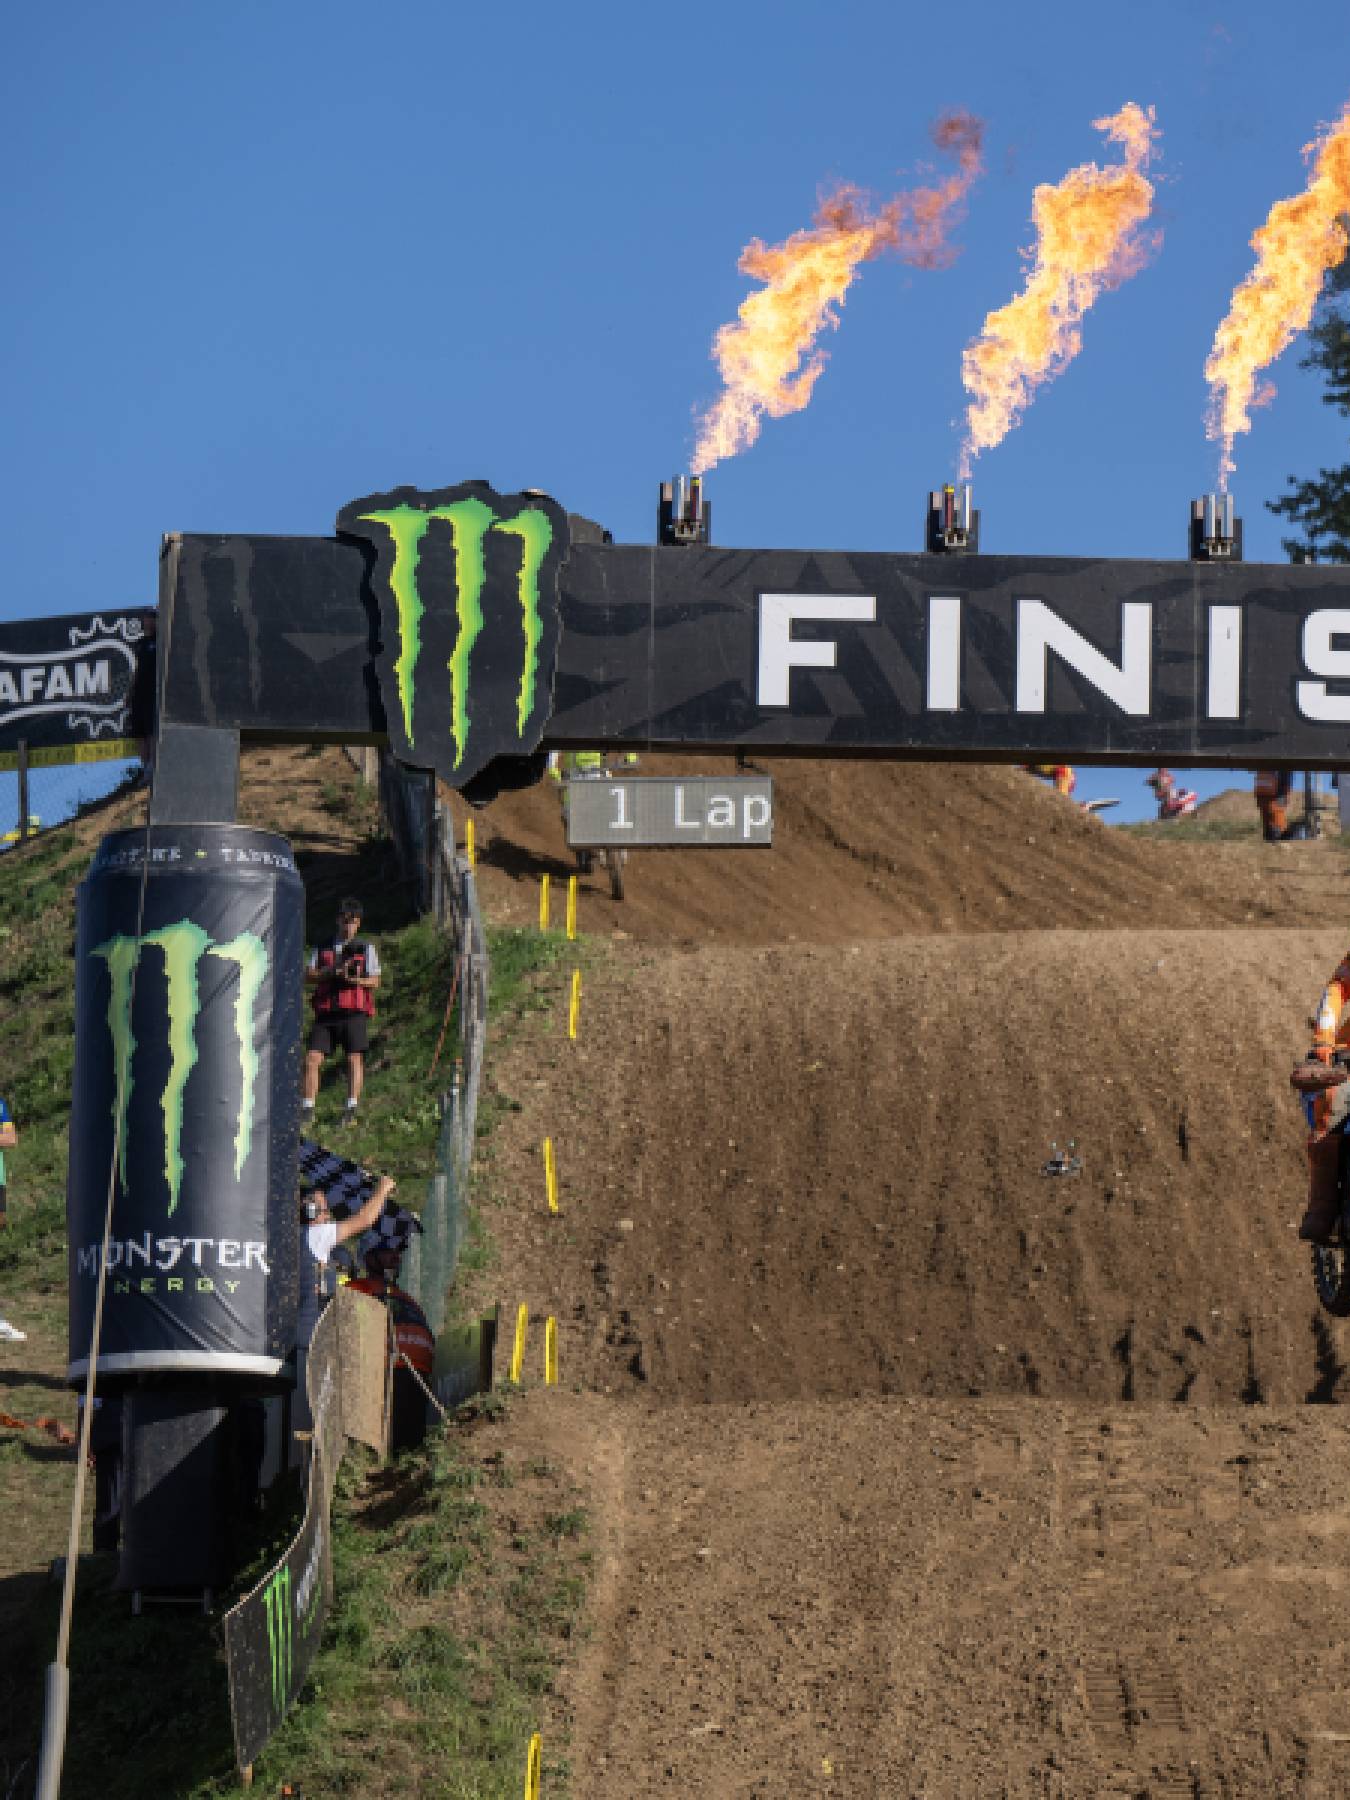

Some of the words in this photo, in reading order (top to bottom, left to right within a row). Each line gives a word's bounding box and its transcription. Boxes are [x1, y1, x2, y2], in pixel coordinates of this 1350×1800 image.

[0, 660, 109, 702] AFAM
[609, 786, 633, 828] 1
[674, 785, 771, 837] Lap
[77, 1230, 271, 1275] MONSTER
[98, 1277, 241, 1294] NERGY
